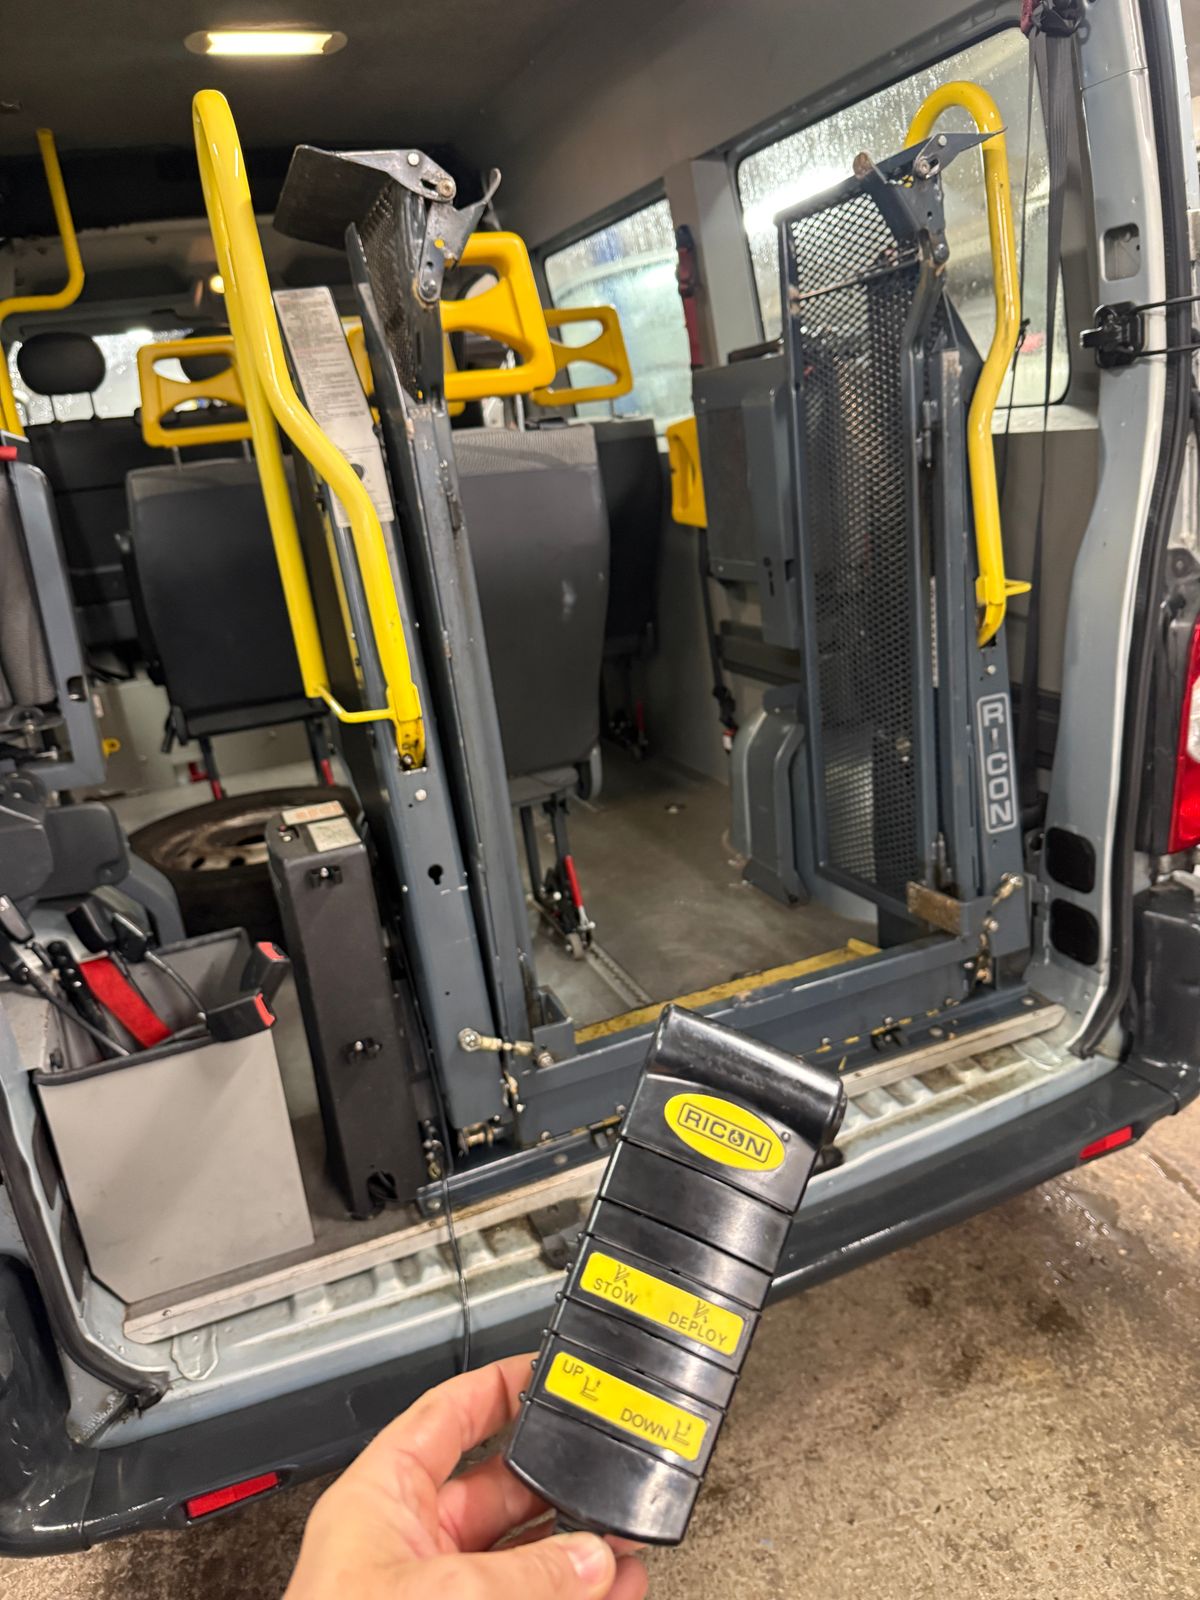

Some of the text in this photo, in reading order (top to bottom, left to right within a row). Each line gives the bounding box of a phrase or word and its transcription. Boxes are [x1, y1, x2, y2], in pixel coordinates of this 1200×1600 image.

[982, 701, 1012, 825] RICON
[683, 1107, 768, 1159] RICON
[593, 1277, 727, 1347] STOW DEPLOY
[563, 1359, 585, 1377] UP
[620, 1408, 669, 1441] DOWN
